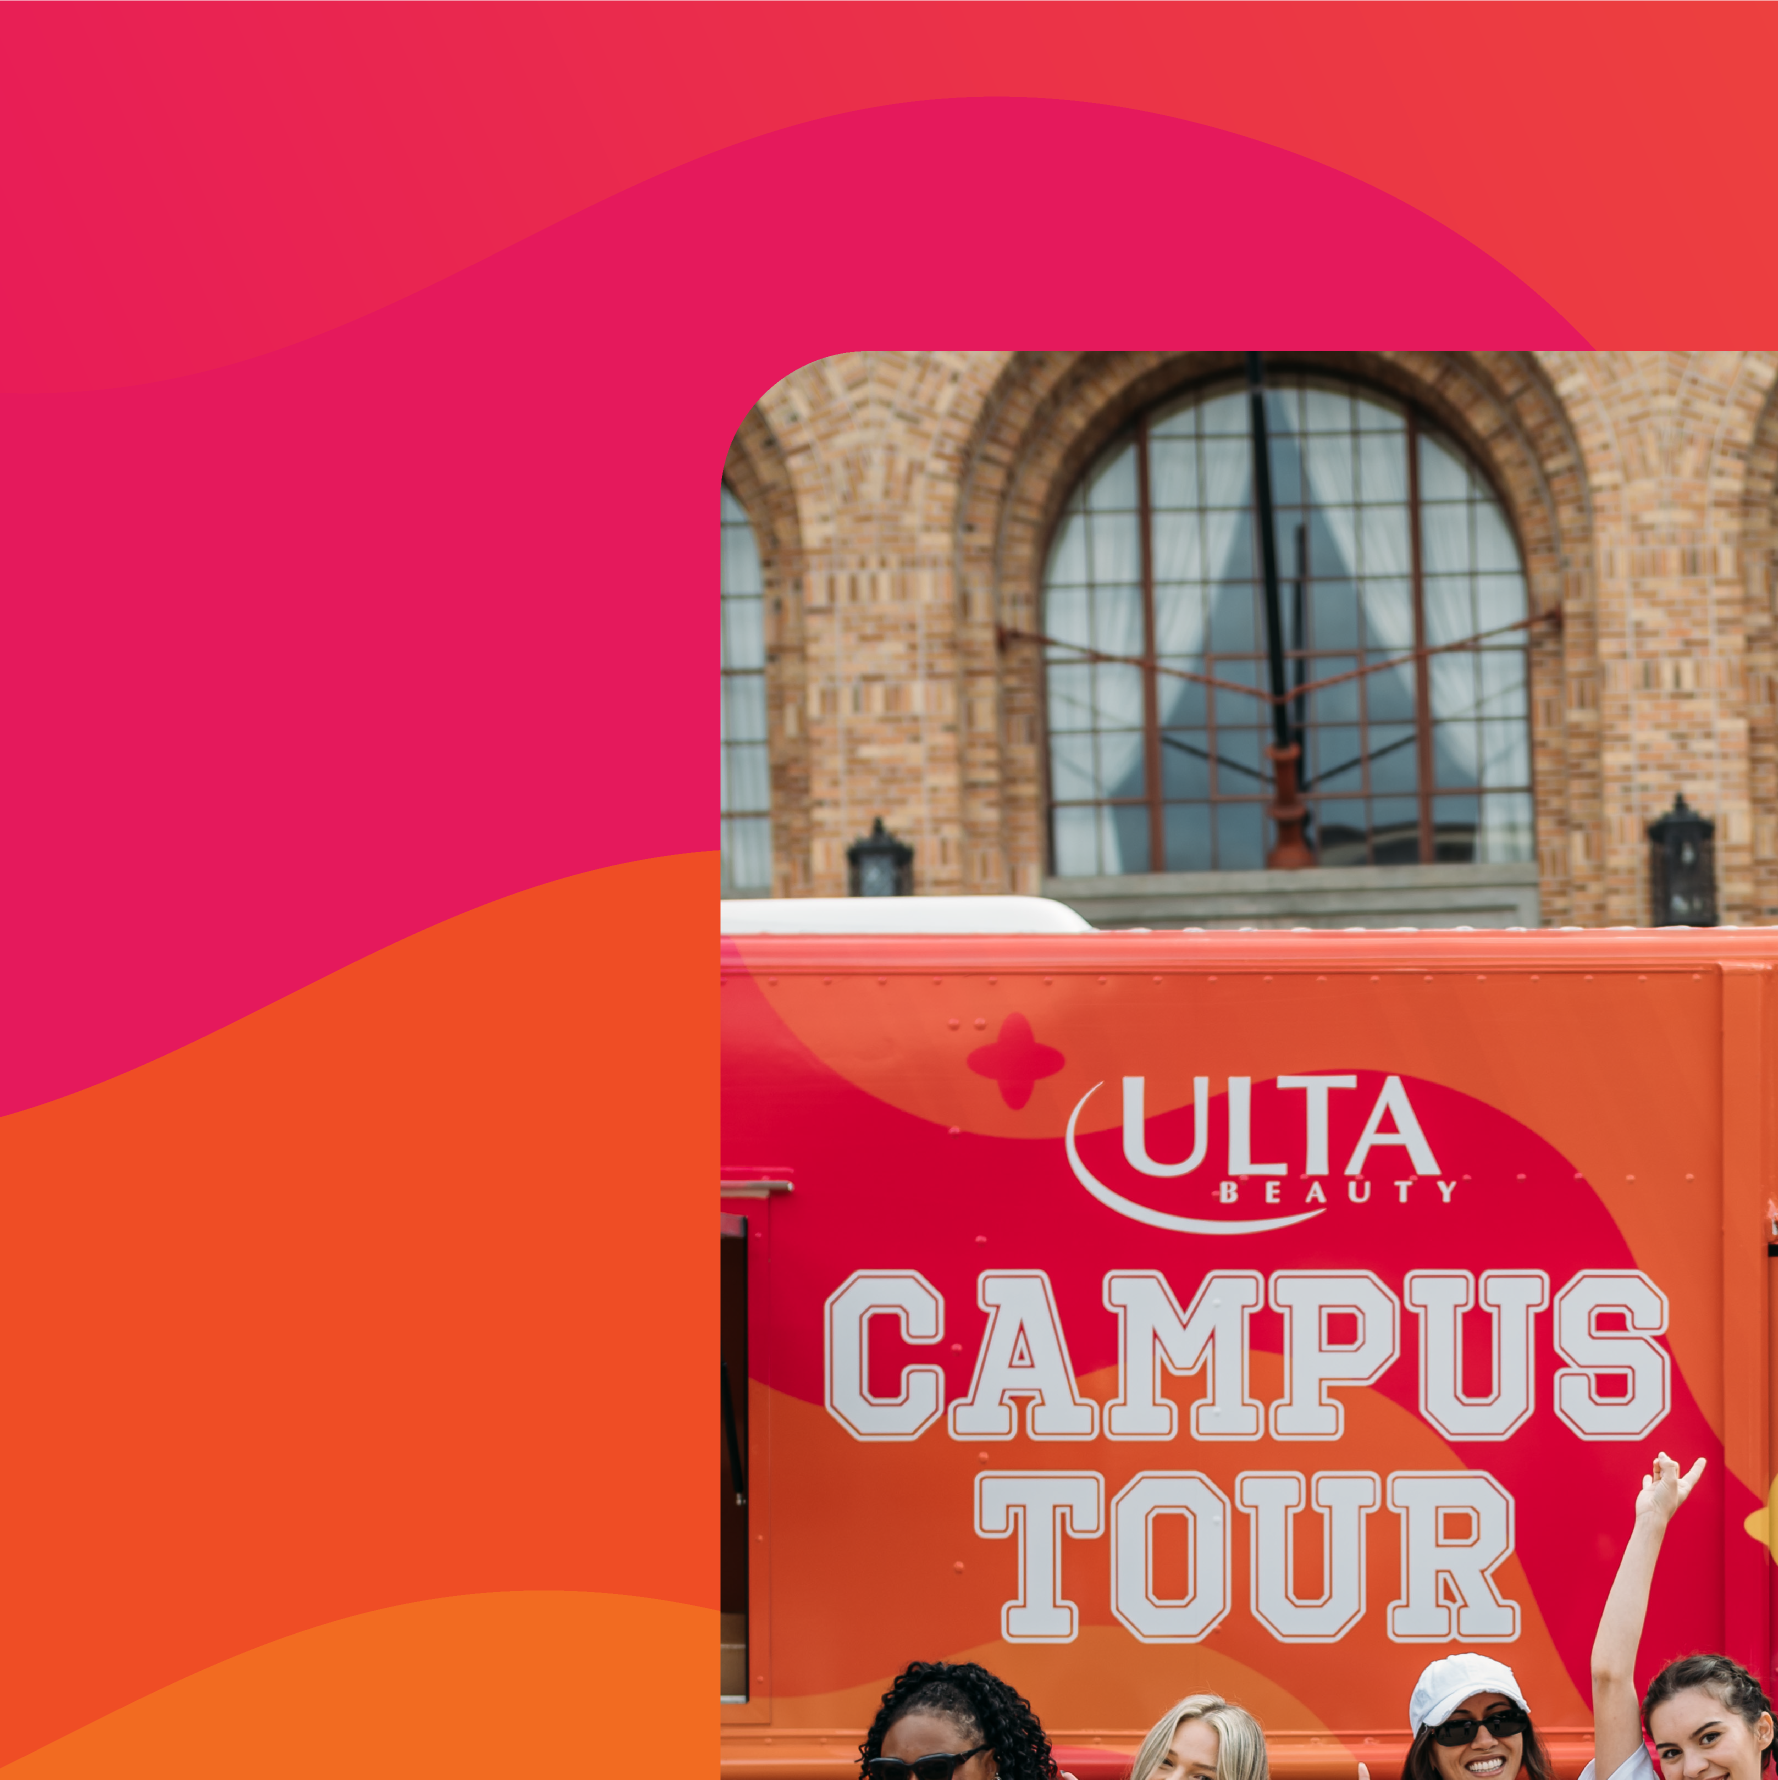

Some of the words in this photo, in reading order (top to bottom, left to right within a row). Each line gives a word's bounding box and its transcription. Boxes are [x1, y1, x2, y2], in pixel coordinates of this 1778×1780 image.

[1121, 1074, 1442, 1178] ULTA
[1219, 1179, 1458, 1204] BEAUTY
[823, 1268, 1671, 1442] CAMPUS
[973, 1470, 1522, 1645] TOUR
